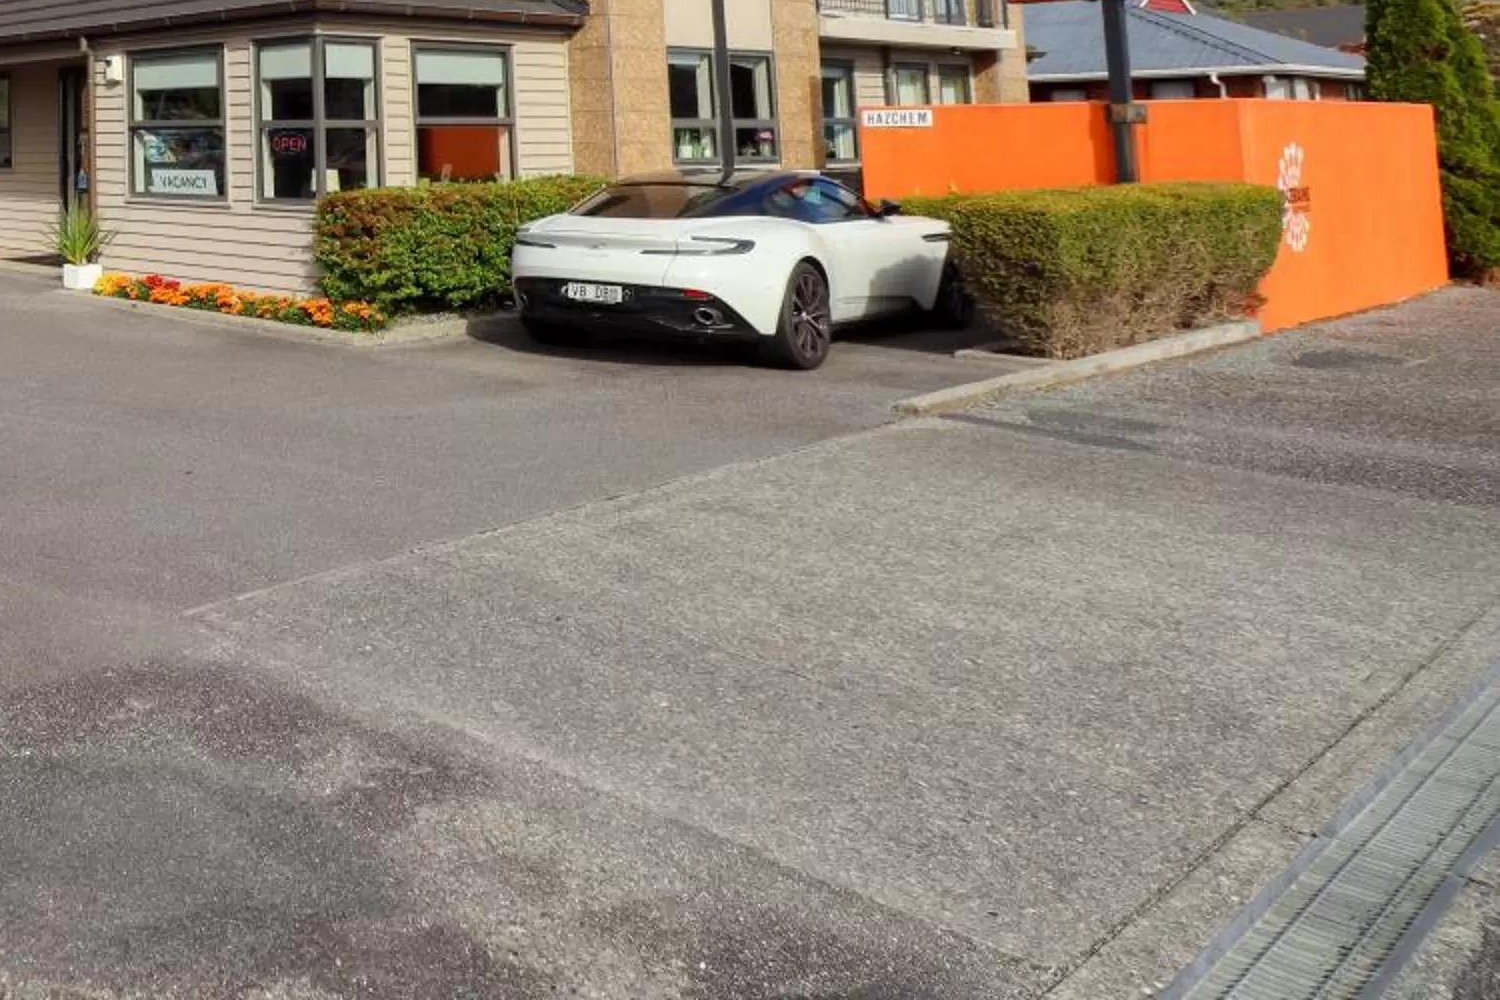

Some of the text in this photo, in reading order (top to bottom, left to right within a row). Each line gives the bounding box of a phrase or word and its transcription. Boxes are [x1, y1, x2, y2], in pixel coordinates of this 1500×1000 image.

[867, 111, 928, 125] HAZCHEM
[273, 136, 307, 151] OPEN
[160, 174, 207, 189] VACANCY
